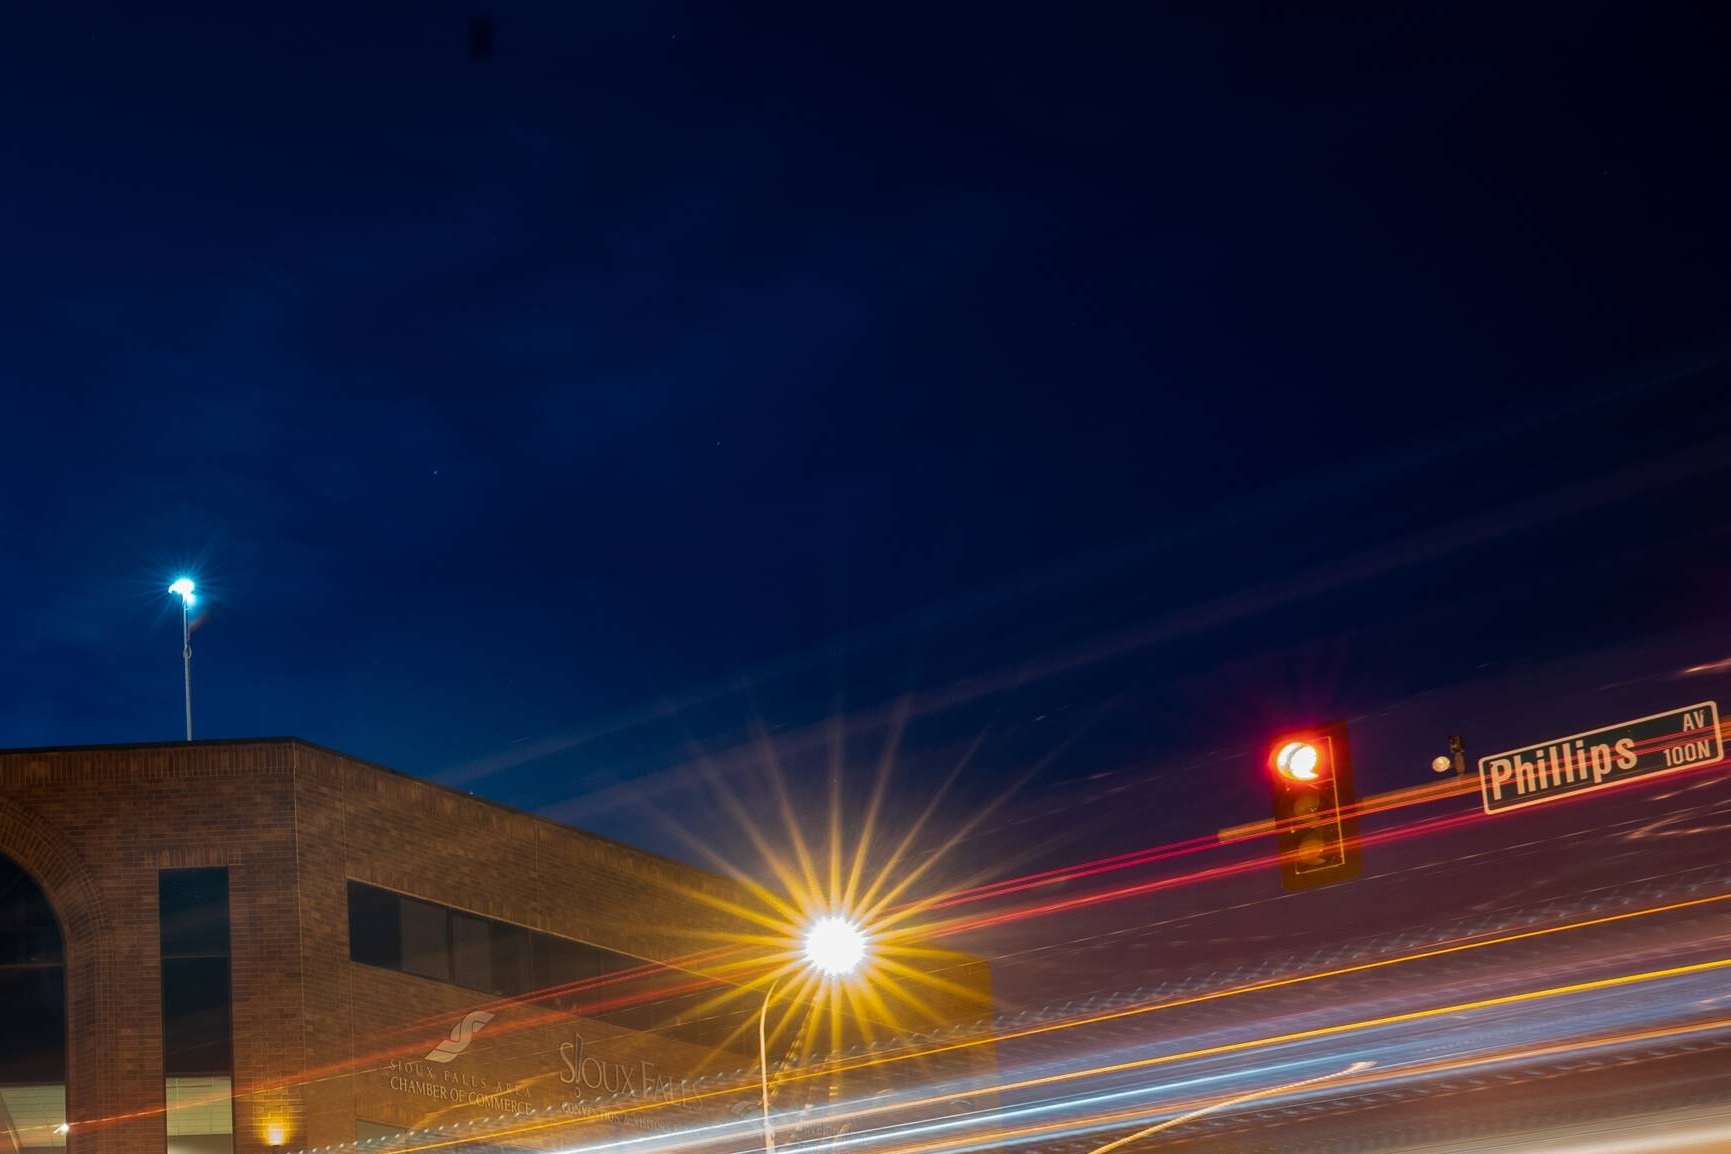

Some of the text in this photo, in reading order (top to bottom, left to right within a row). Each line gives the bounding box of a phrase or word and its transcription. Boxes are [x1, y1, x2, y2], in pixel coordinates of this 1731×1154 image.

[1683, 709, 1705, 733] AV
[1489, 737, 1639, 801] Phillips
[1663, 739, 1711, 767] 100N
[390, 1059, 434, 1079] SIOUX
[444, 1070, 487, 1089] FALLS
[560, 1032, 636, 1098] SIOUX
[390, 1076, 533, 1115] CHAMBER OF COMMERCE
